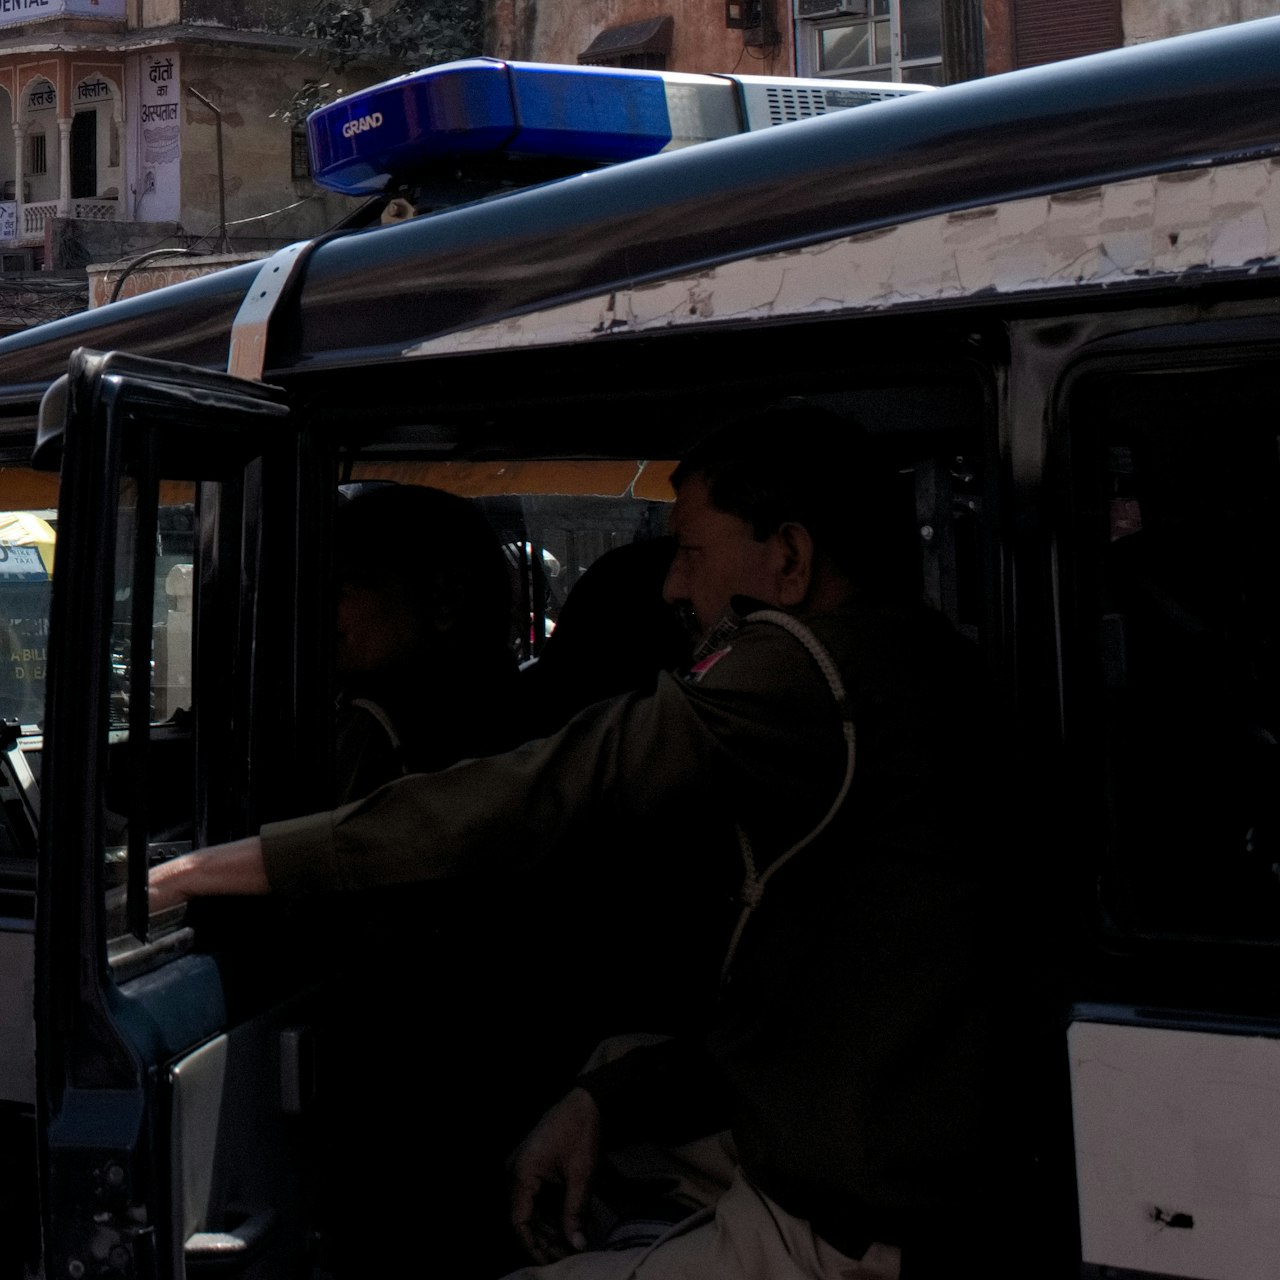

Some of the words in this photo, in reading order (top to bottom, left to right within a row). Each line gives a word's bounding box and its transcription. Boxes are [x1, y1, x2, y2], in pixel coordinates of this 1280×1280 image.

[156, 85, 168, 97] का
[141, 102, 178, 123] अस्पताल
[342, 112, 383, 138] GRAND
[14, 557, 34, 565] TAXI
